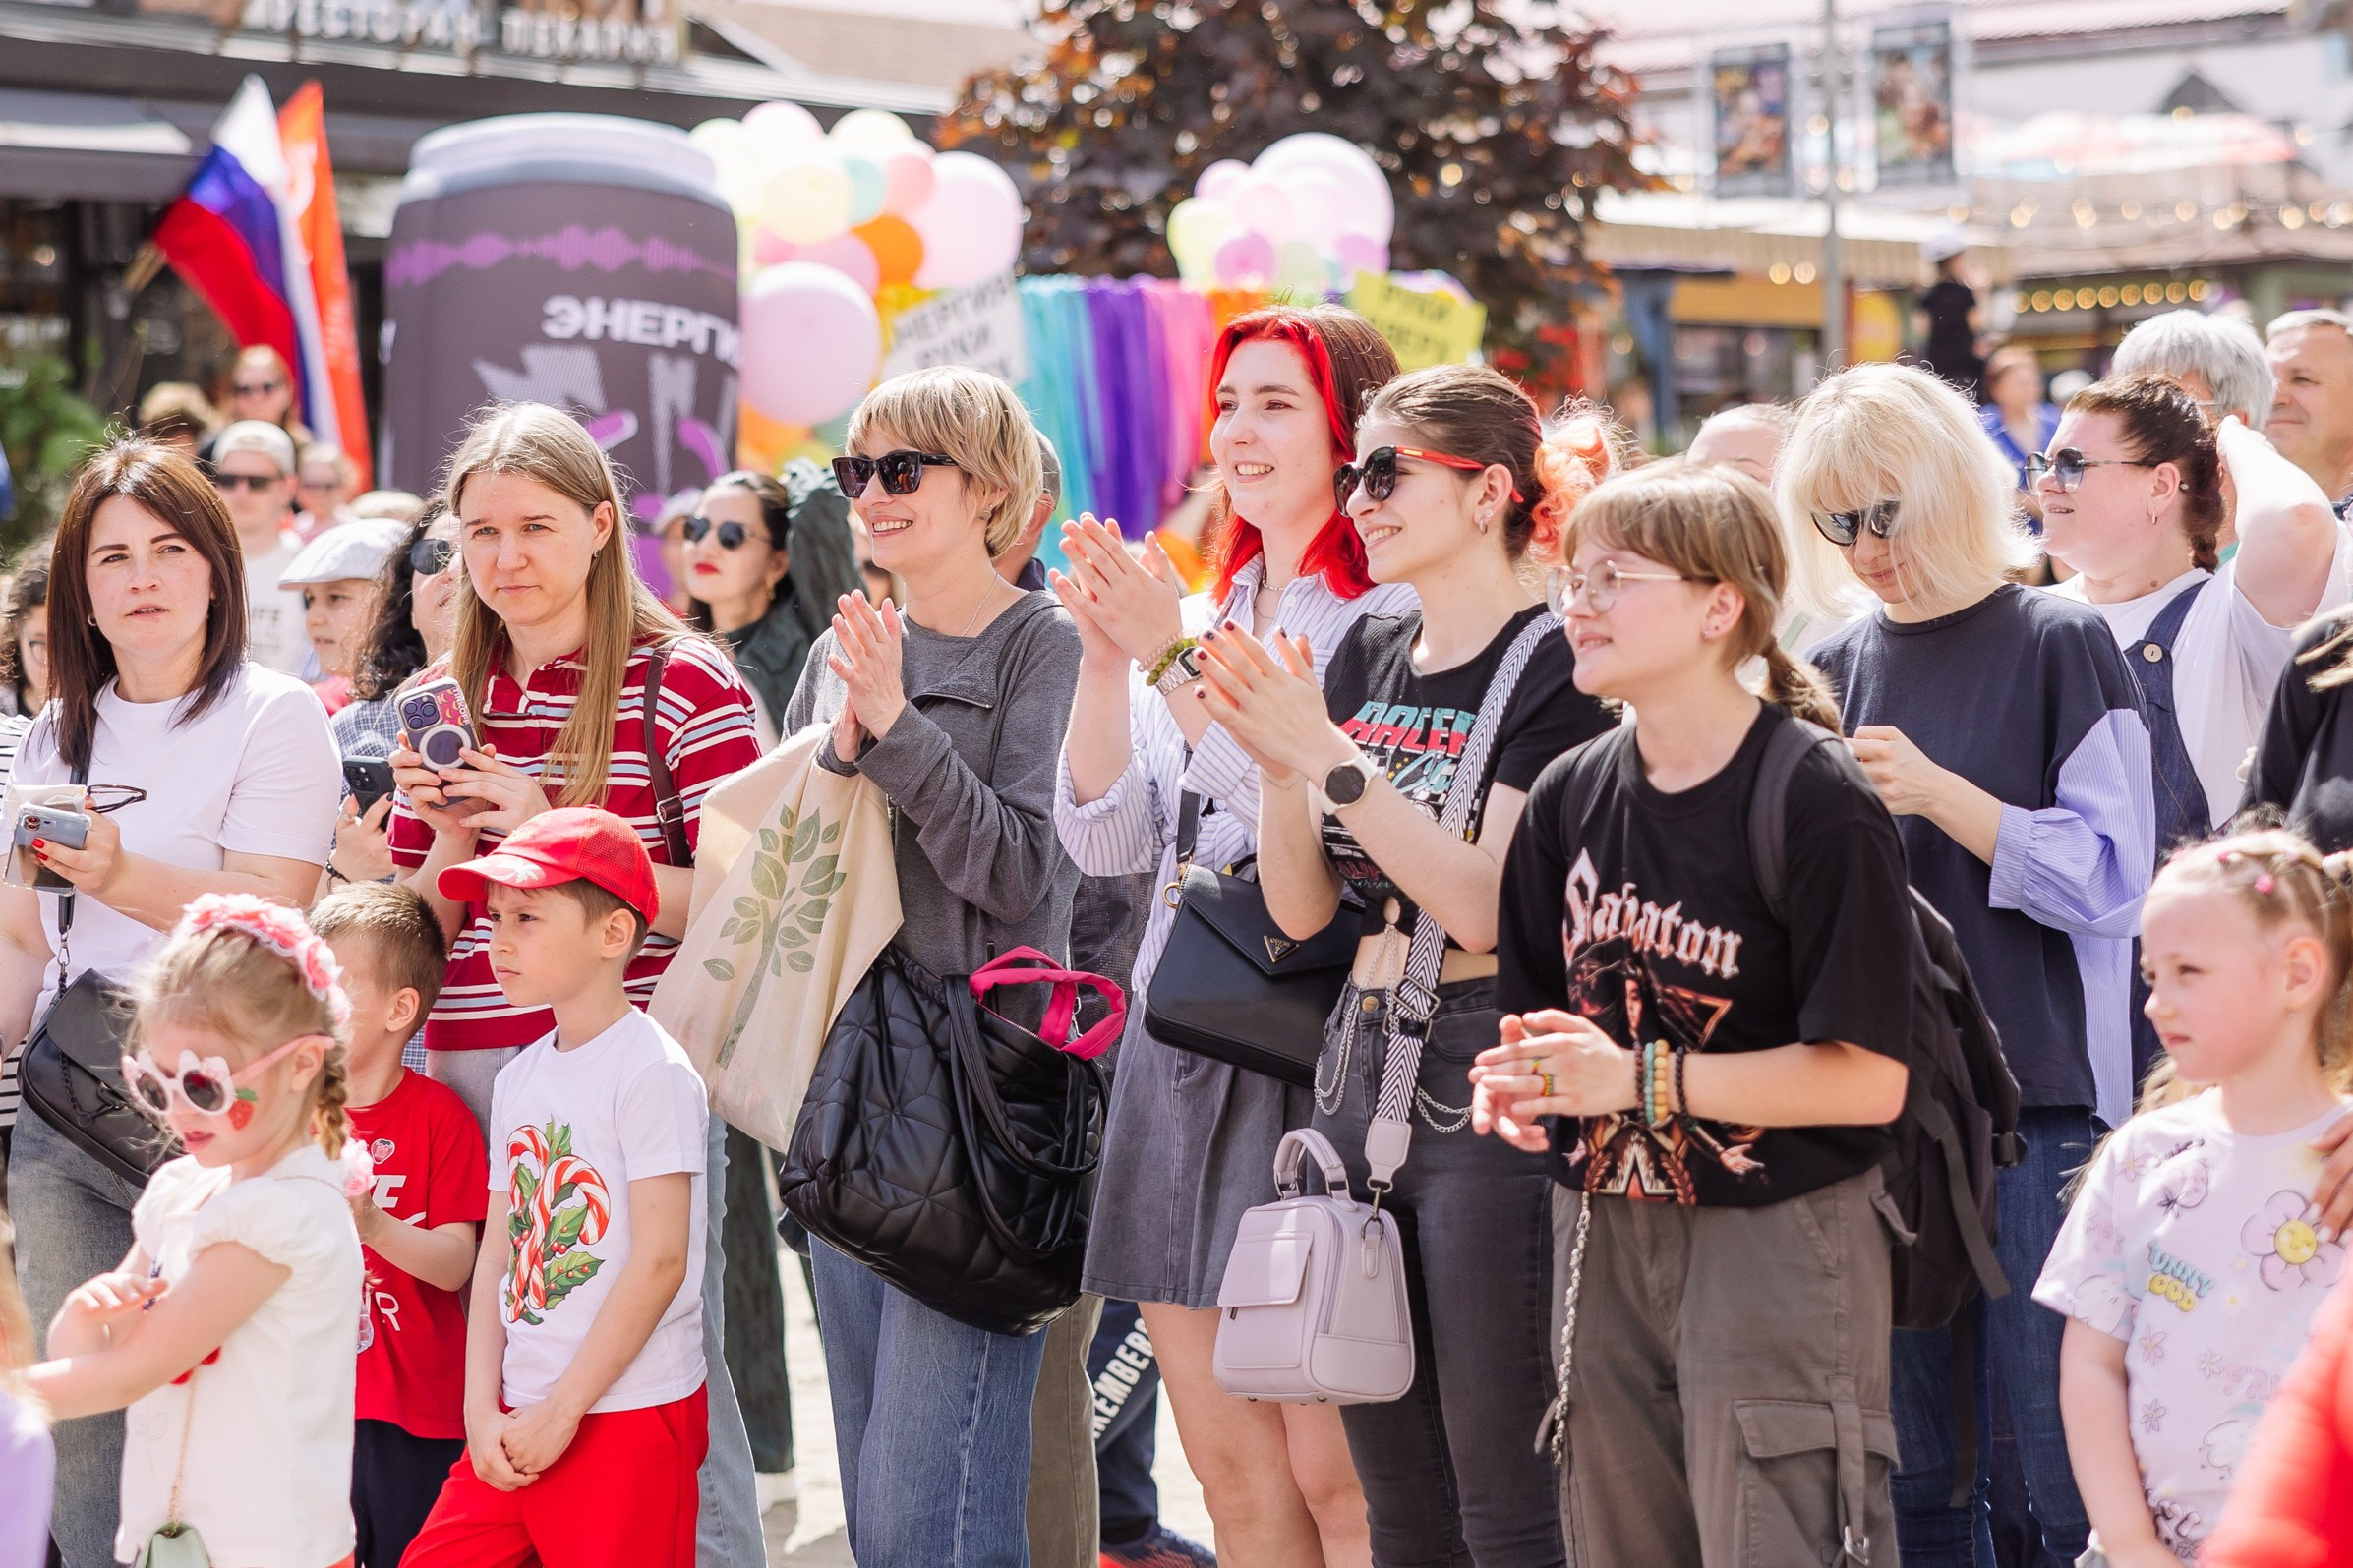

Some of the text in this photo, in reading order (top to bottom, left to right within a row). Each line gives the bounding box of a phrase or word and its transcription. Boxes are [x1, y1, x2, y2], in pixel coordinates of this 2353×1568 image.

[1561, 846, 1743, 980] Sabaton
[2146, 1273, 2197, 1313] OOD
[2147, 1241, 2215, 1299] UNNY
